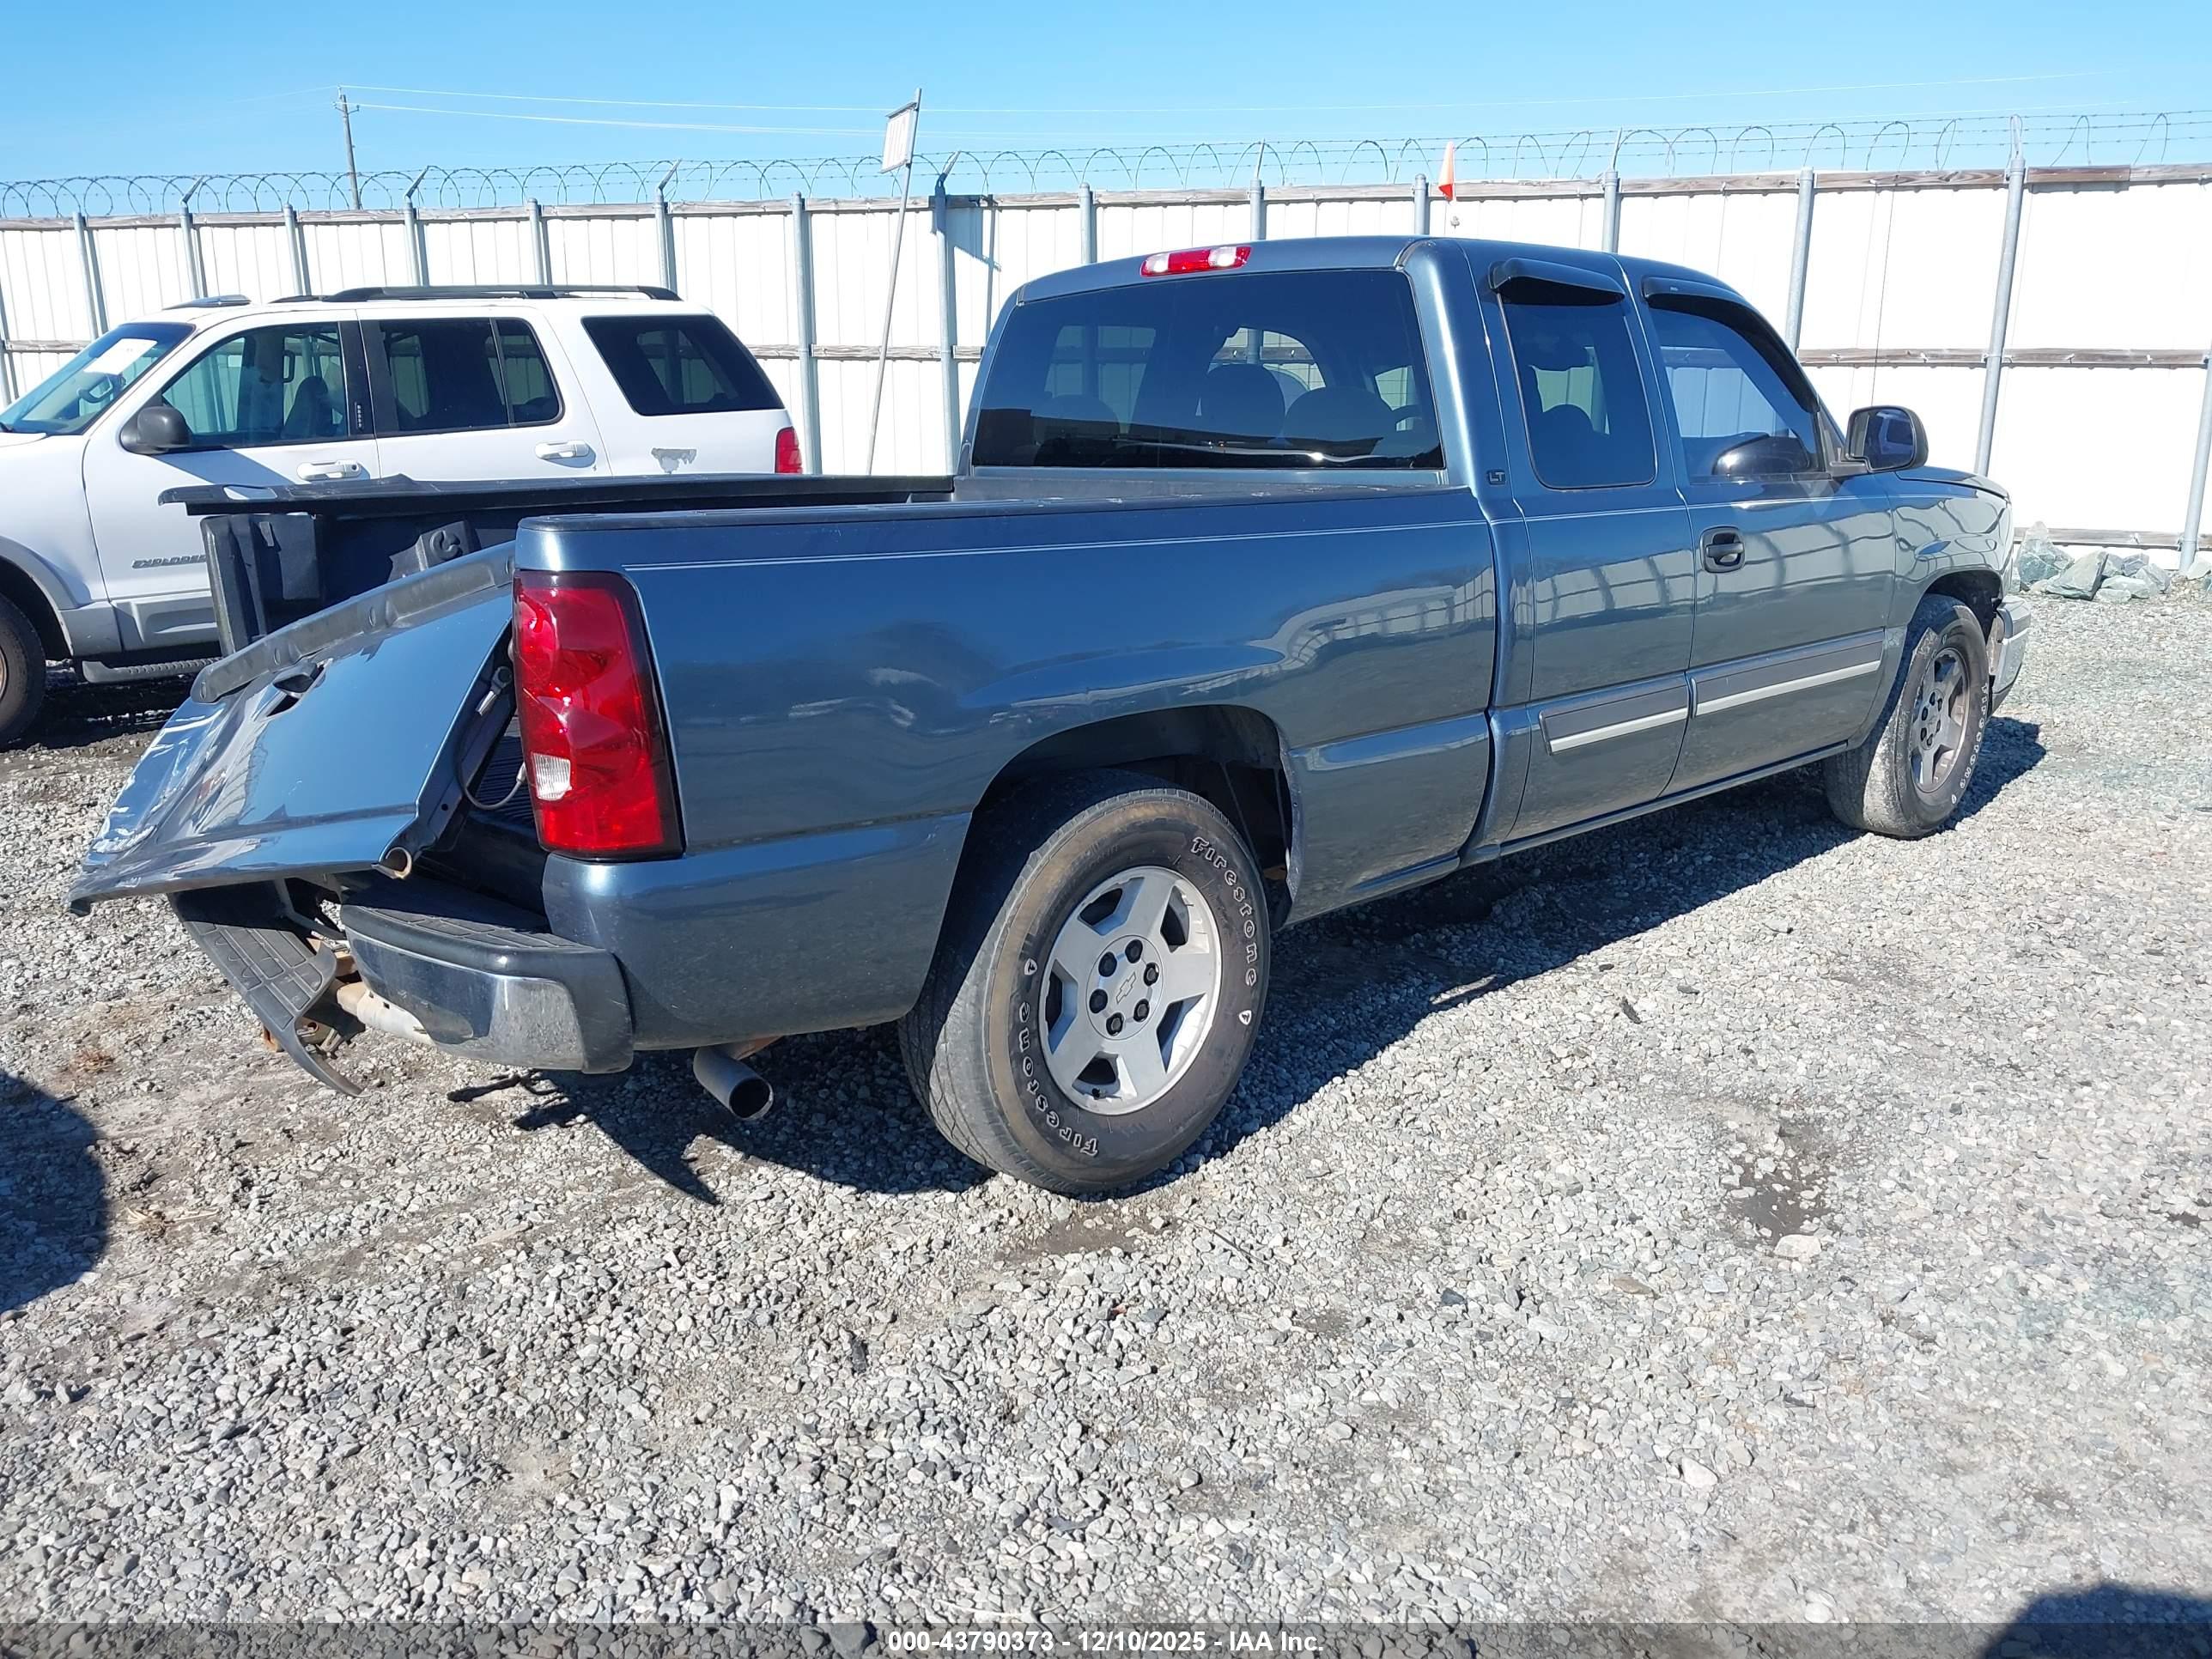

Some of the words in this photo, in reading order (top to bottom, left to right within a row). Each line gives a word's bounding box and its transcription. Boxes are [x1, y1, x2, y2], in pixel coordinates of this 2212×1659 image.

[1489, 471, 1504, 482] LT
[1190, 836, 1258, 987] Firestone
[1019, 1001, 1098, 1156] Firestone
